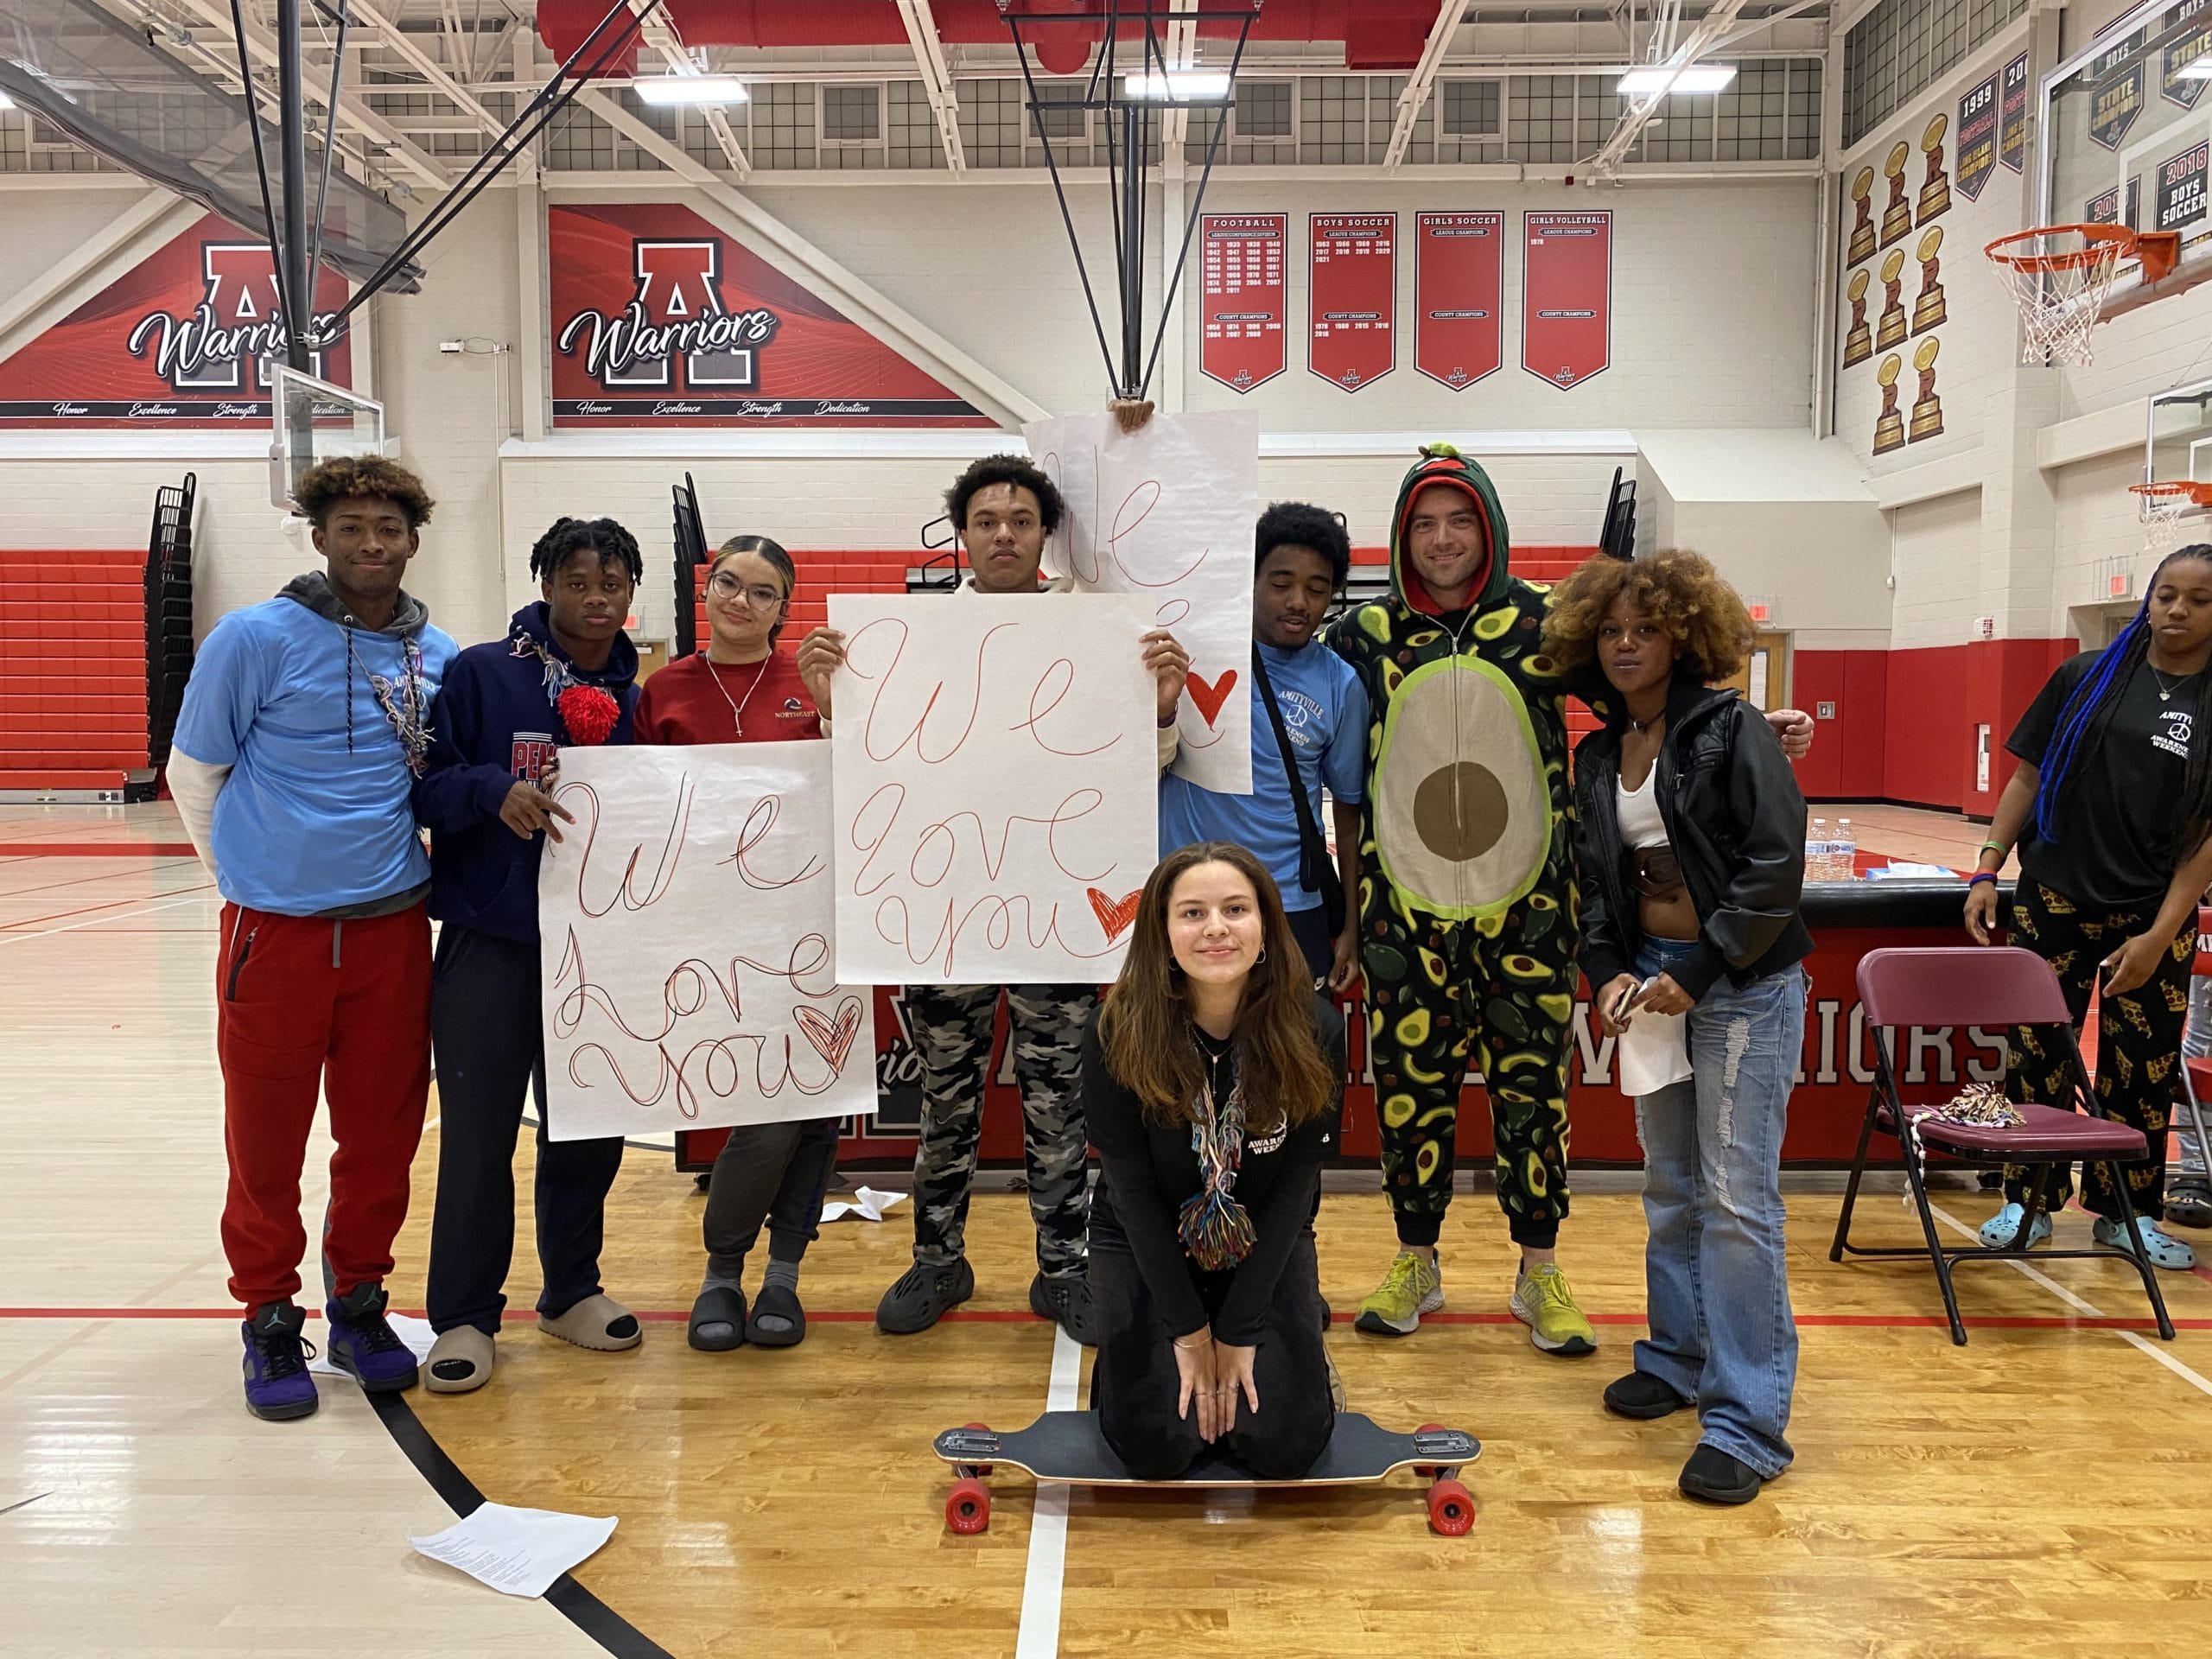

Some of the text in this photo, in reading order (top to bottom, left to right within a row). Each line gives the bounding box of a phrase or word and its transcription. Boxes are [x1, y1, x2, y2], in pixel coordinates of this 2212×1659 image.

[2106, 41, 2129, 70] BOYS
[2171, 30, 2212, 69] STATE
[1964, 85, 1992, 118] 1999
[2098, 77, 2134, 113] STATE
[1958, 111, 1995, 148] FOOTBALL
[2166, 147, 2207, 185] 2018
[2094, 186, 2129, 221] 201
[2162, 192, 2207, 226] SOCCER
[2171, 178, 2200, 206] BOYS
[560, 302, 777, 378] Warriors
[53, 403, 88, 416] Honor
[129, 403, 177, 416] Excellence
[213, 404, 258, 420] Strength
[576, 401, 870, 419] Honor Excellence Strength Dedication
[845, 618, 1123, 763] We
[1279, 690, 1324, 720] AMITYVILLE
[548, 771, 827, 918] We
